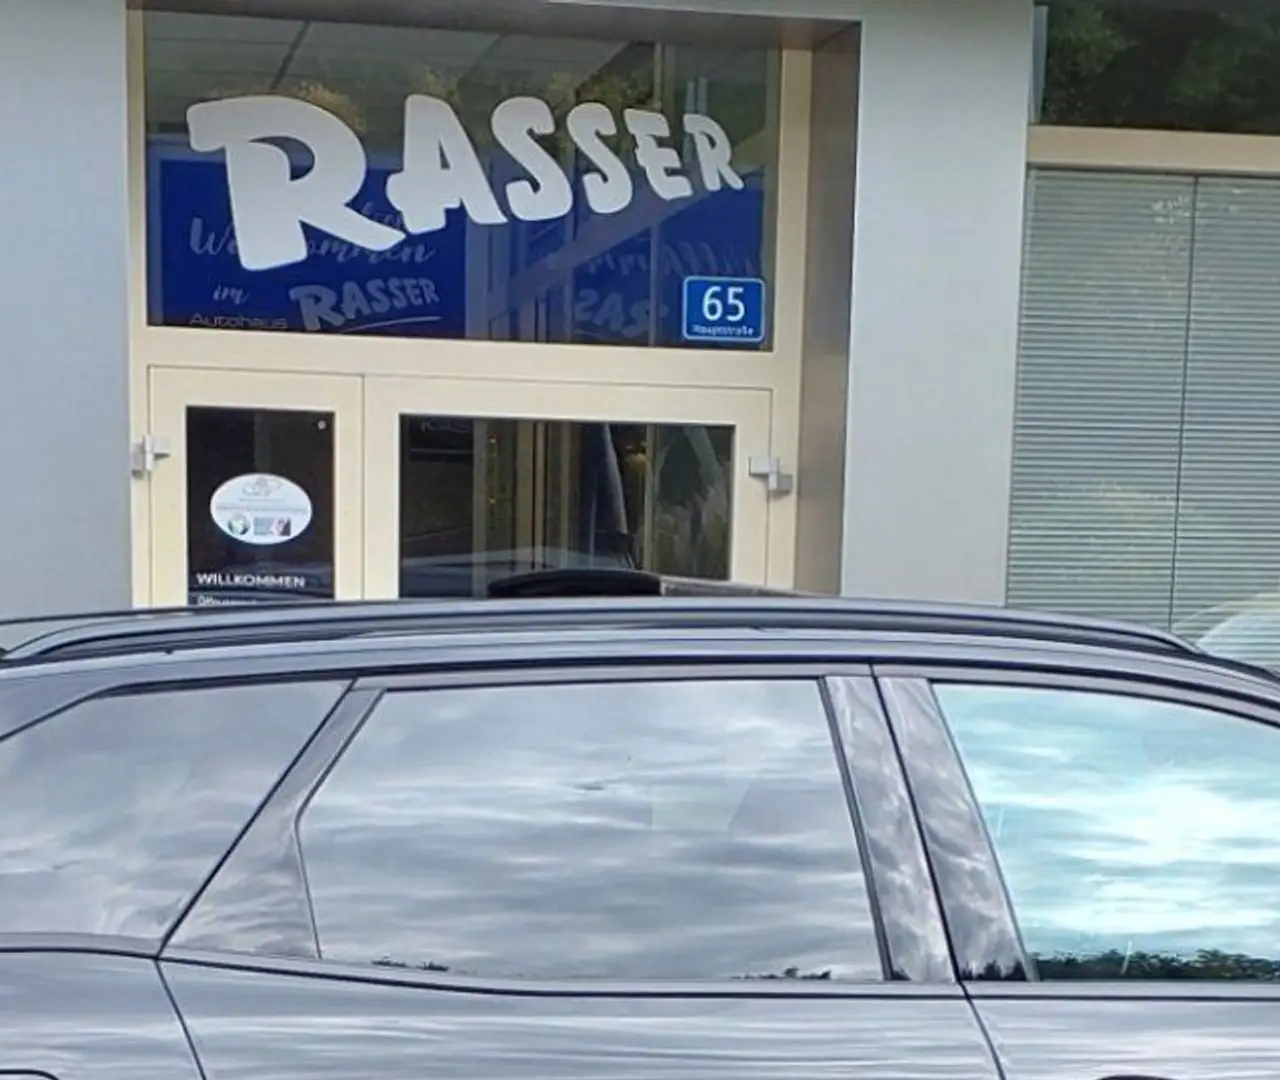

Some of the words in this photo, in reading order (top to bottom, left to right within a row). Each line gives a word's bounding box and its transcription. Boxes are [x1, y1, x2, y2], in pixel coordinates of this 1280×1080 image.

[186, 95, 745, 271] RASSER
[189, 311, 289, 330] Autohaus
[289, 277, 440, 332] RASSER
[702, 285, 746, 322] 65
[195, 572, 307, 589] WILLKOMMEN
